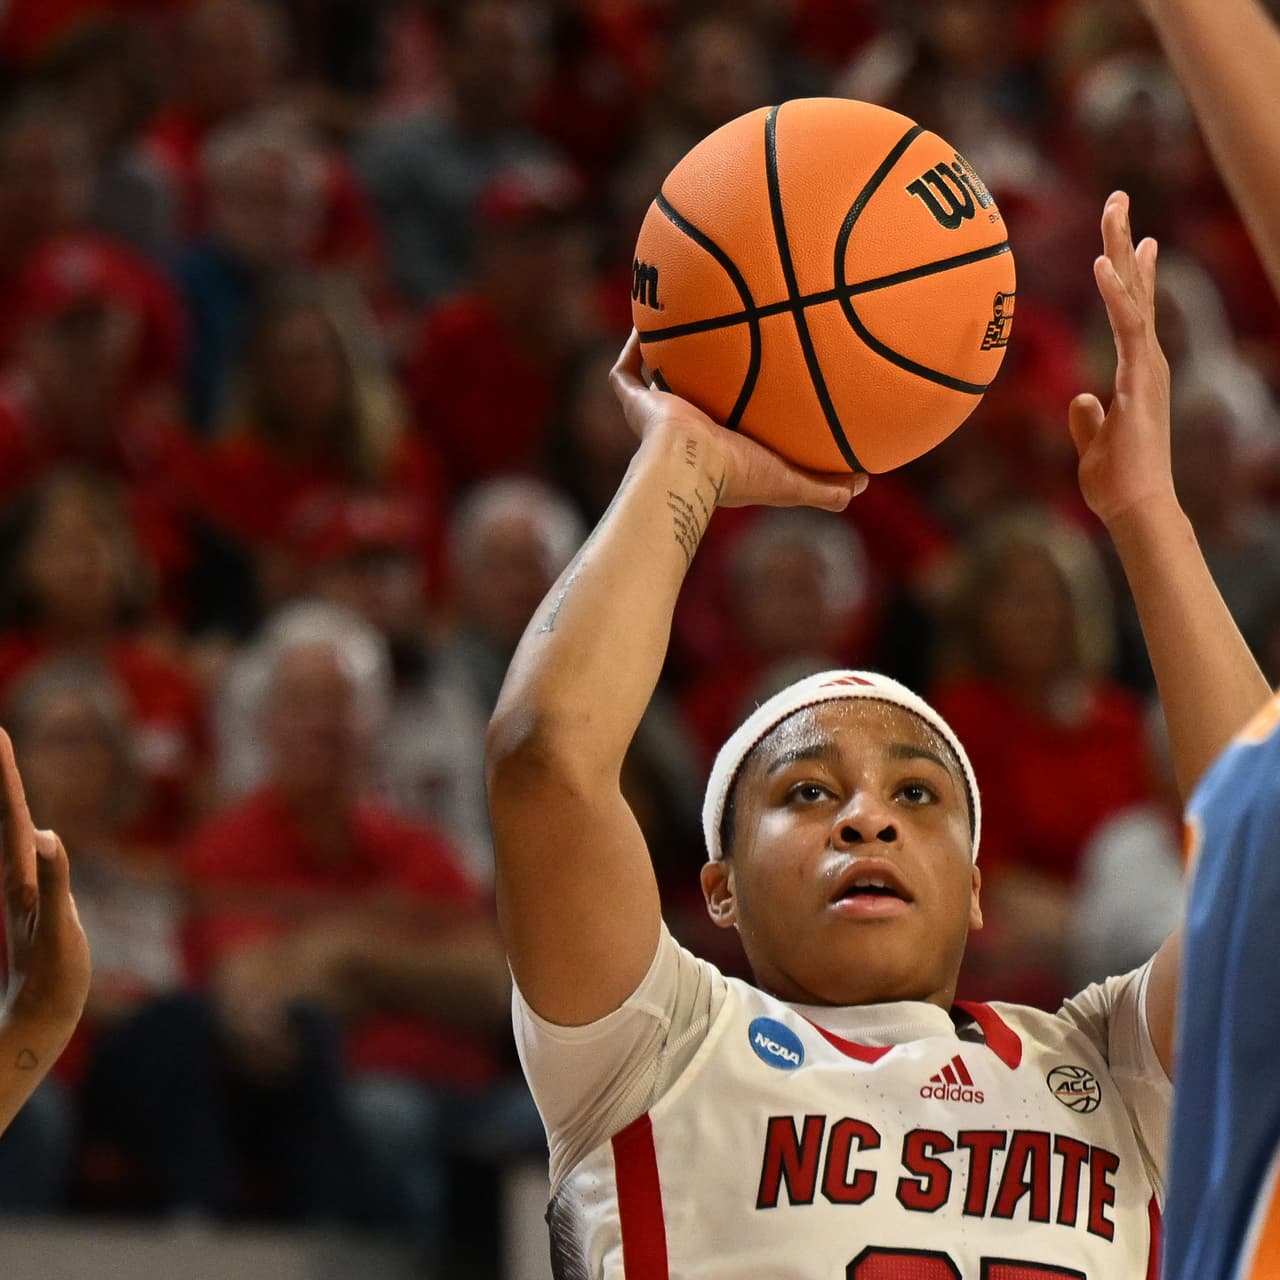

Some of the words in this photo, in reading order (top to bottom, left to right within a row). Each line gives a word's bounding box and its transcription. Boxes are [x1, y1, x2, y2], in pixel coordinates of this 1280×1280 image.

[755, 1032, 800, 1065] NCAA
[920, 1083, 985, 1105] adidas
[1056, 1078, 1097, 1092] ACC
[756, 1114, 881, 1210] NC
[896, 1128, 1121, 1243] STATE
